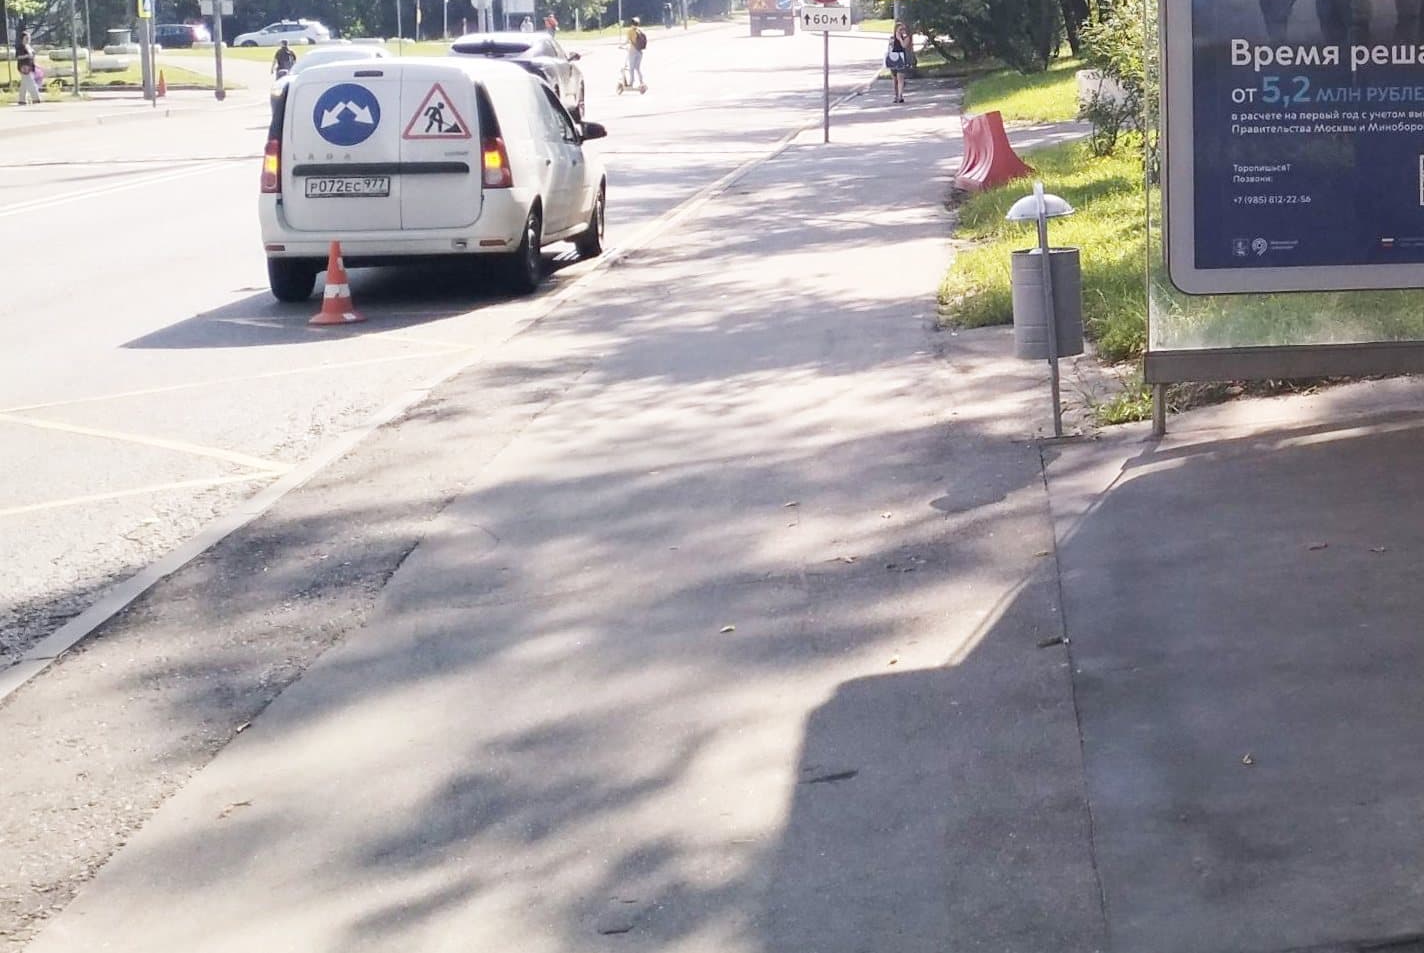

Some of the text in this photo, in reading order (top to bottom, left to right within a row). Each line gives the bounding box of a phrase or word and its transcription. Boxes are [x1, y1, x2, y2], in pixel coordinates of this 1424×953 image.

[1231, 39, 1340, 72] Время
[1262, 75, 1312, 108] 5,2
[1315, 87, 1362, 103] МЛН
[1284, 112, 1297, 120] на
[1342, 111, 1360, 120] год
[1231, 124, 1312, 135] Правительства
[1313, 123, 1358, 133] Москвы
